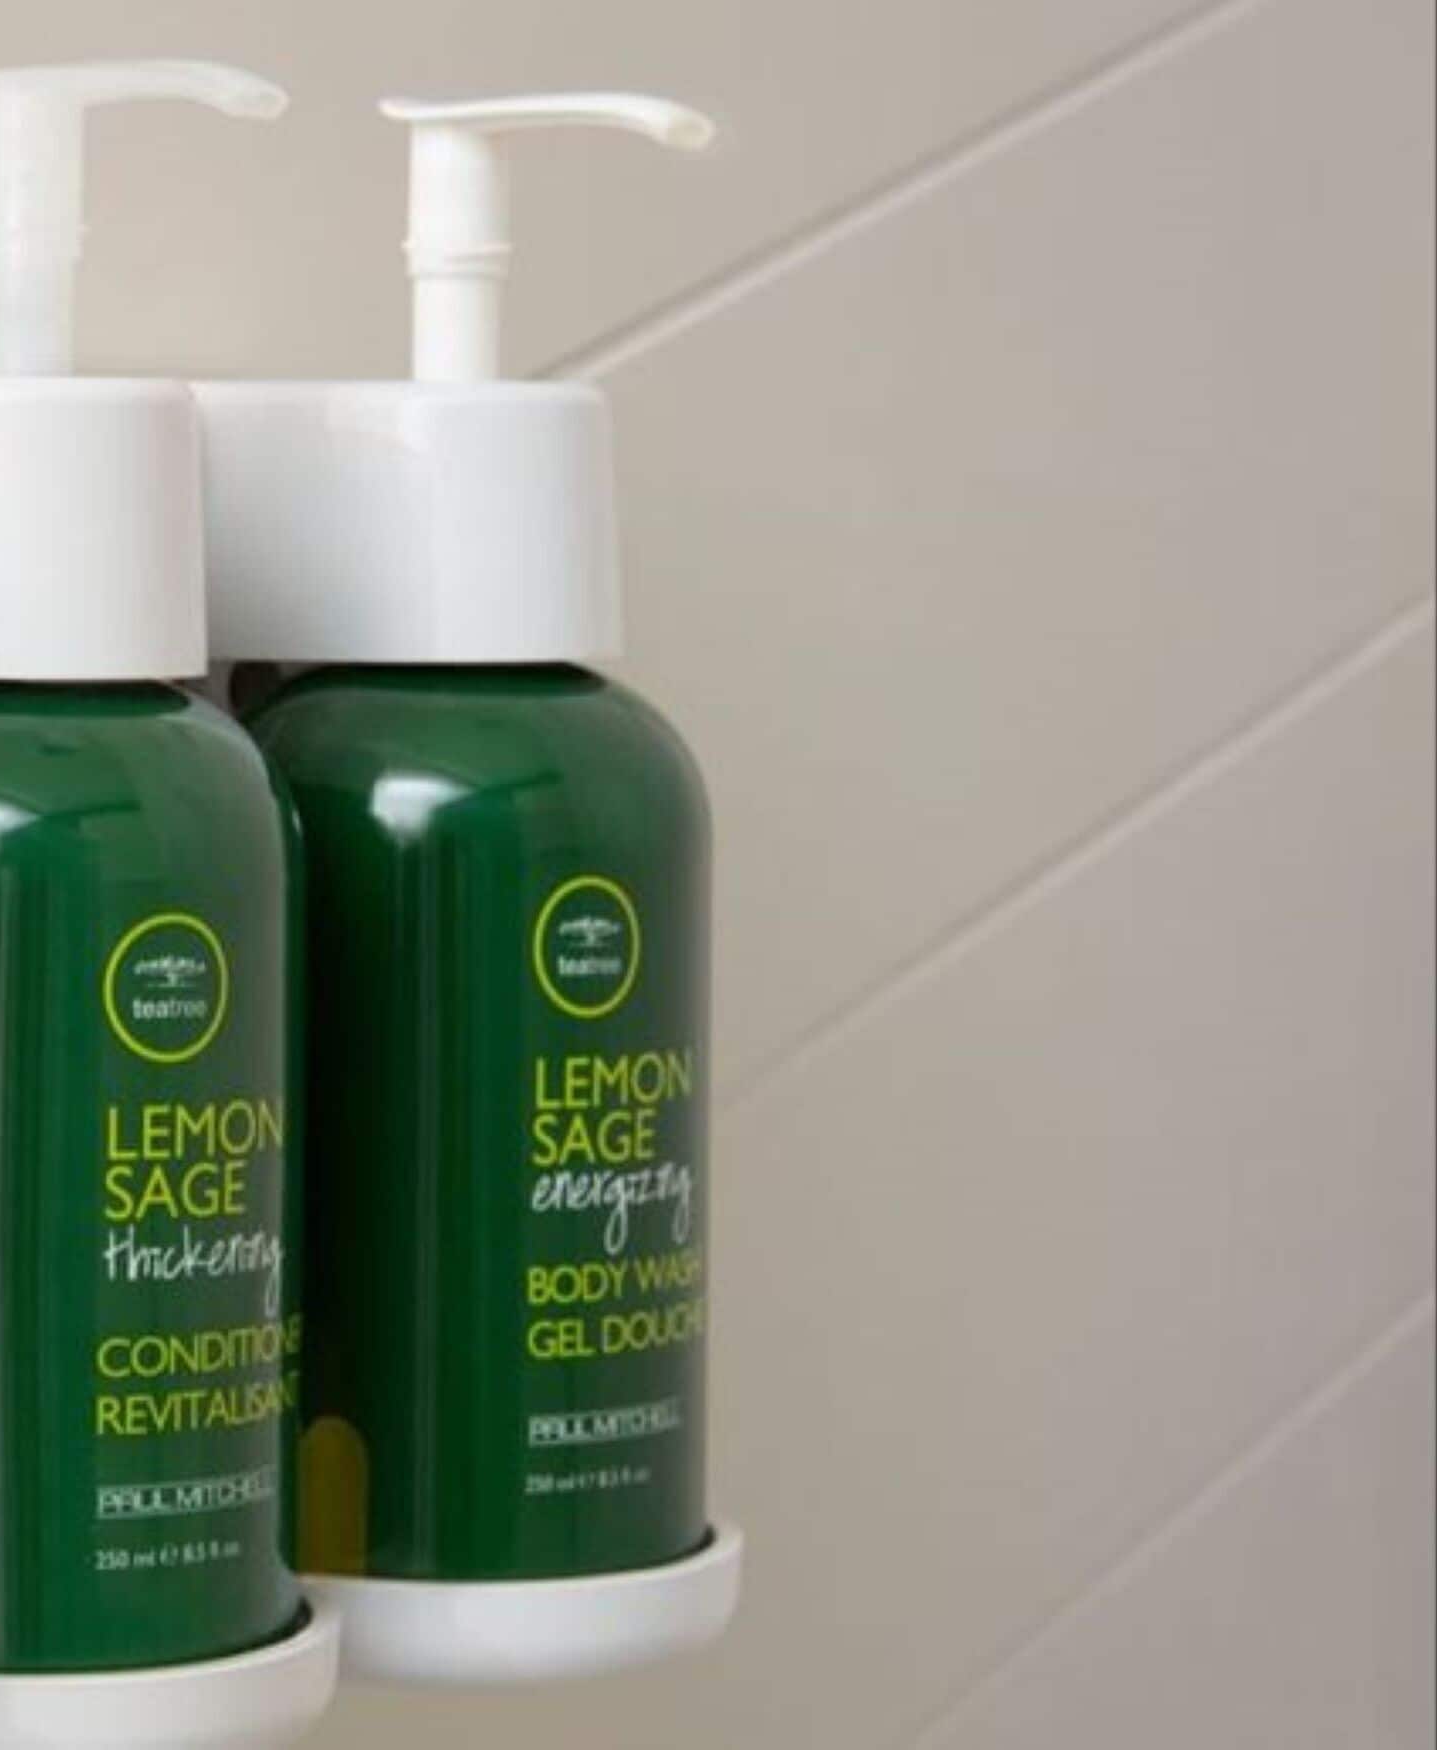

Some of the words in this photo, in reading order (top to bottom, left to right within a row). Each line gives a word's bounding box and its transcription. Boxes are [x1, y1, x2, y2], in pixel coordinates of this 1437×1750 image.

[132, 998, 207, 1020] teatree
[535, 1047, 692, 1109] LEMON
[107, 1100, 283, 1160] LEMON
[533, 1108, 657, 1166] SAGE
[104, 1160, 246, 1222] SAGE
[528, 1259, 628, 1304] BODY
[528, 1319, 595, 1359] GEL
